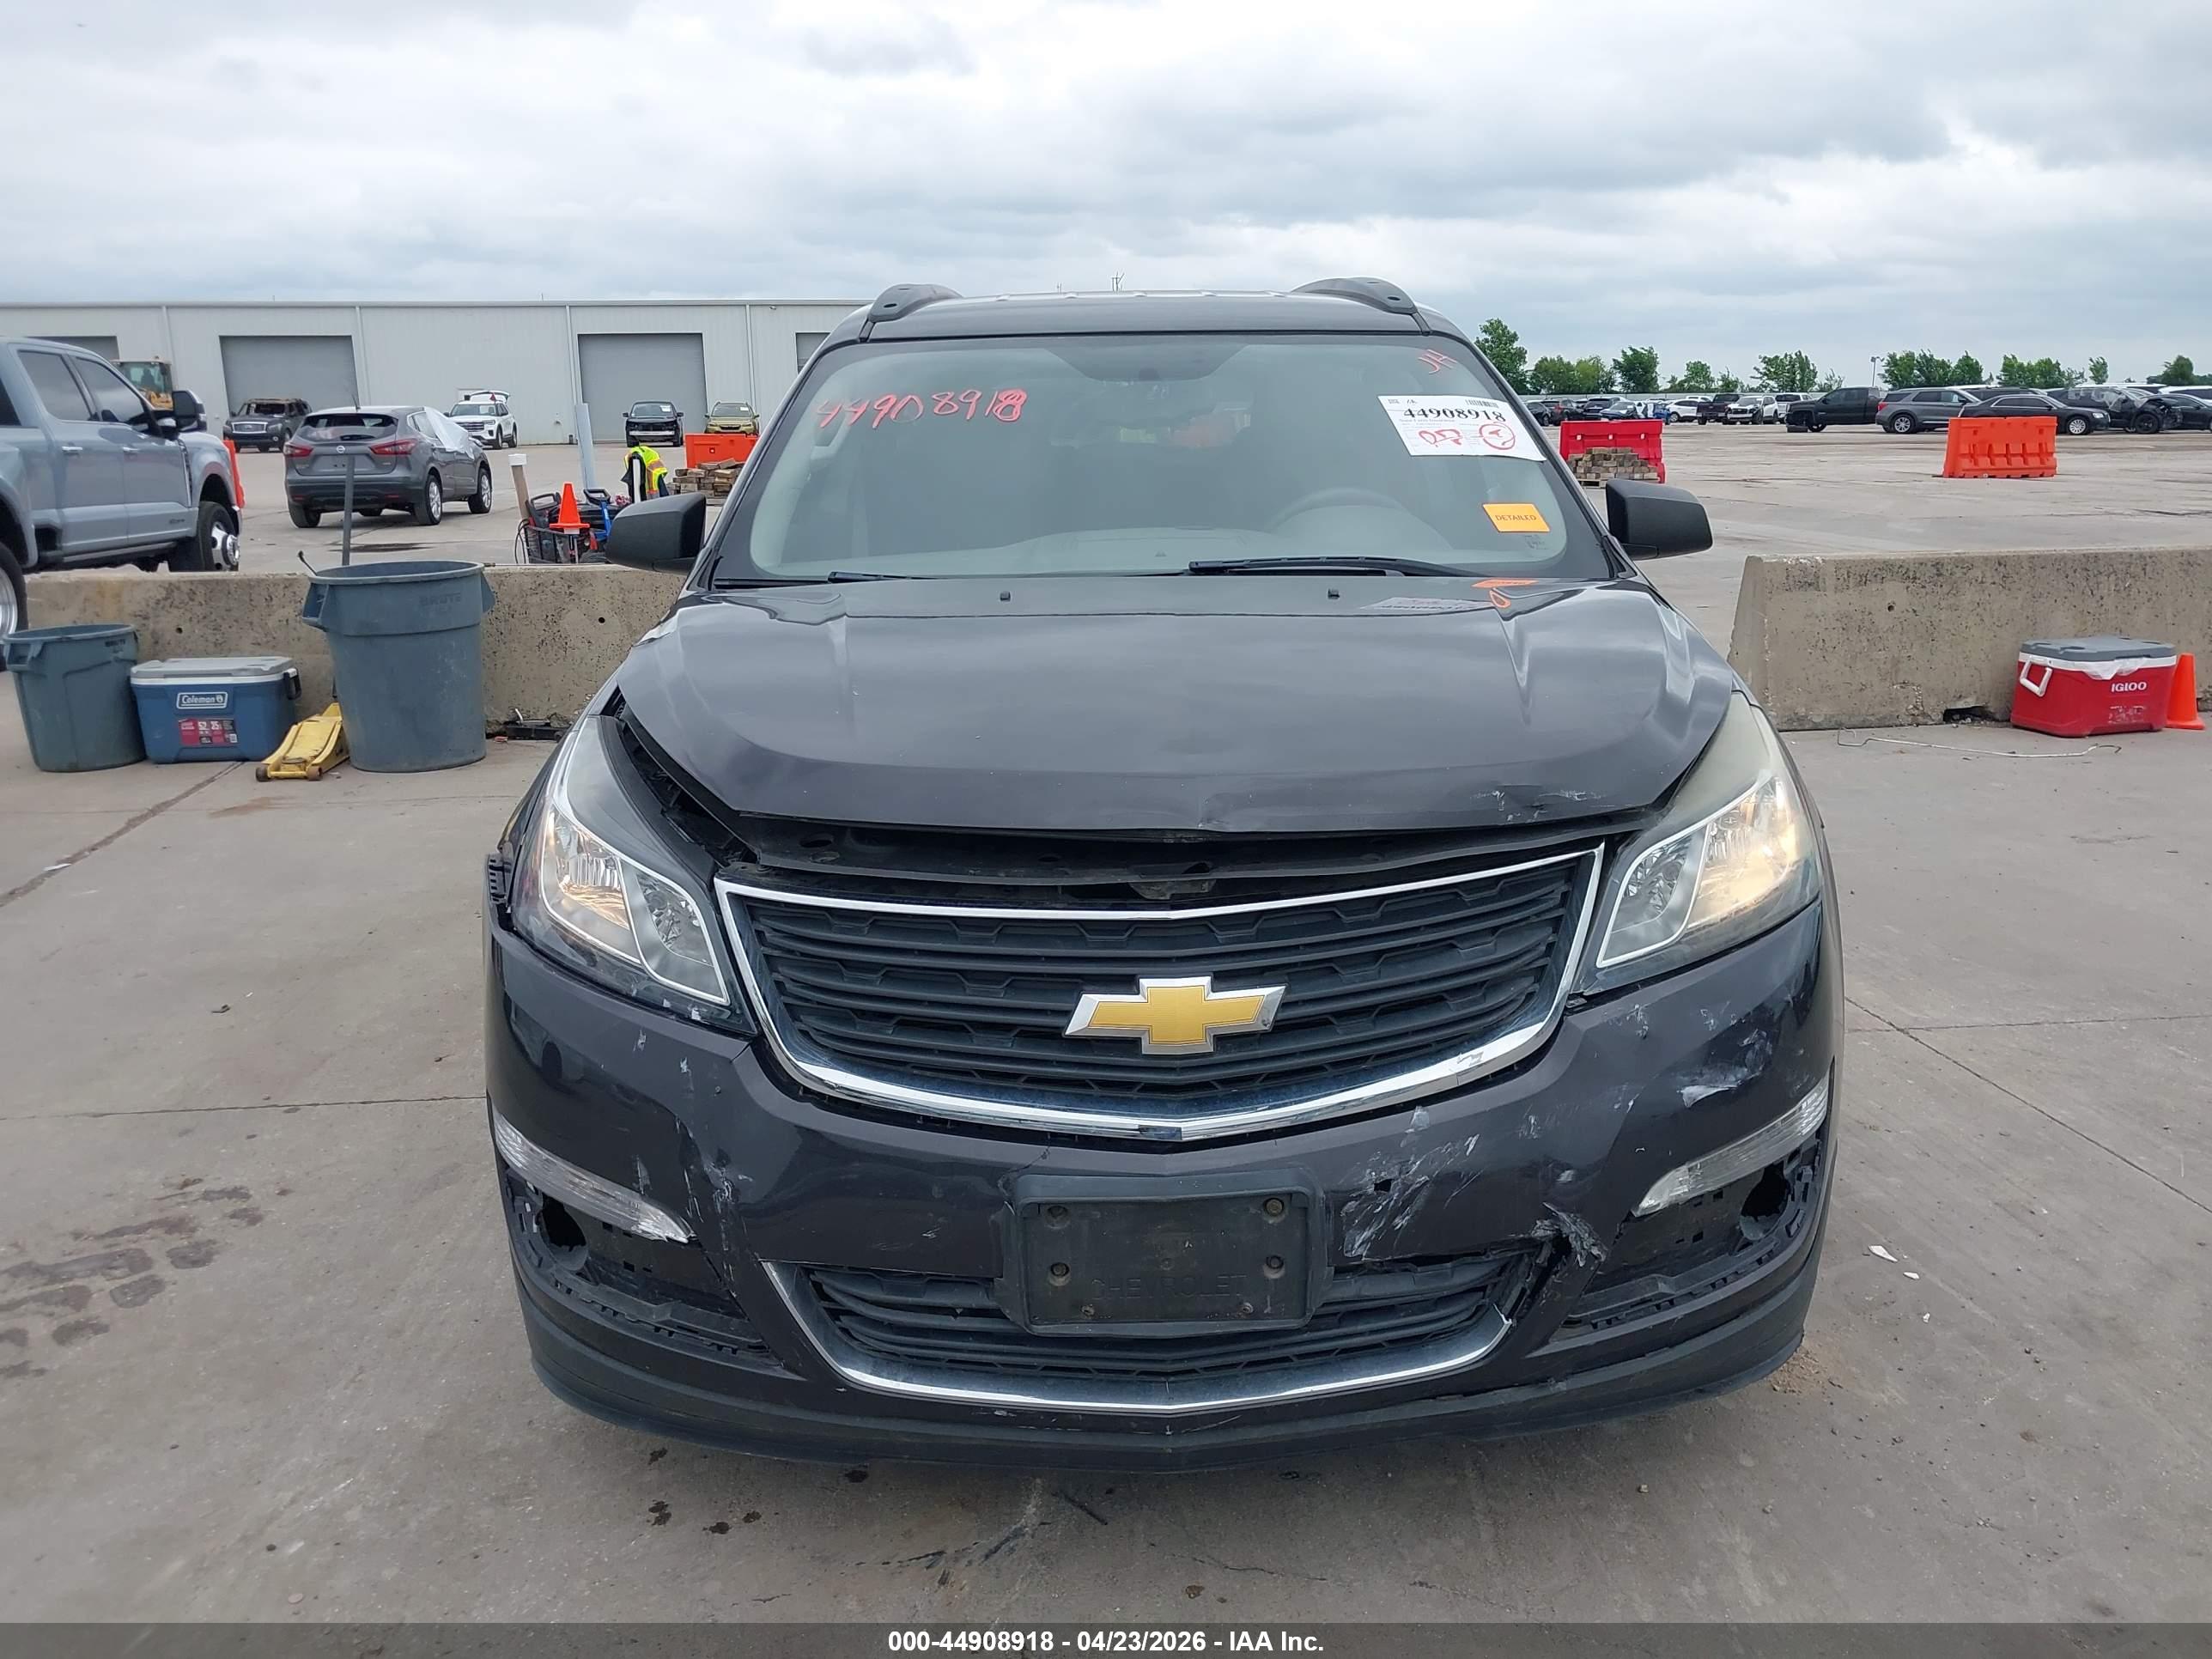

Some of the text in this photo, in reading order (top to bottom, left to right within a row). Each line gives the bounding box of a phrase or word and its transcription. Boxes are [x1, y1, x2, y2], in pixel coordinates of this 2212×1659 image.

[1404, 408, 1506, 422] 44908918
[2111, 681, 2148, 693] IGLOO
[181, 695, 215, 703] Coleman
